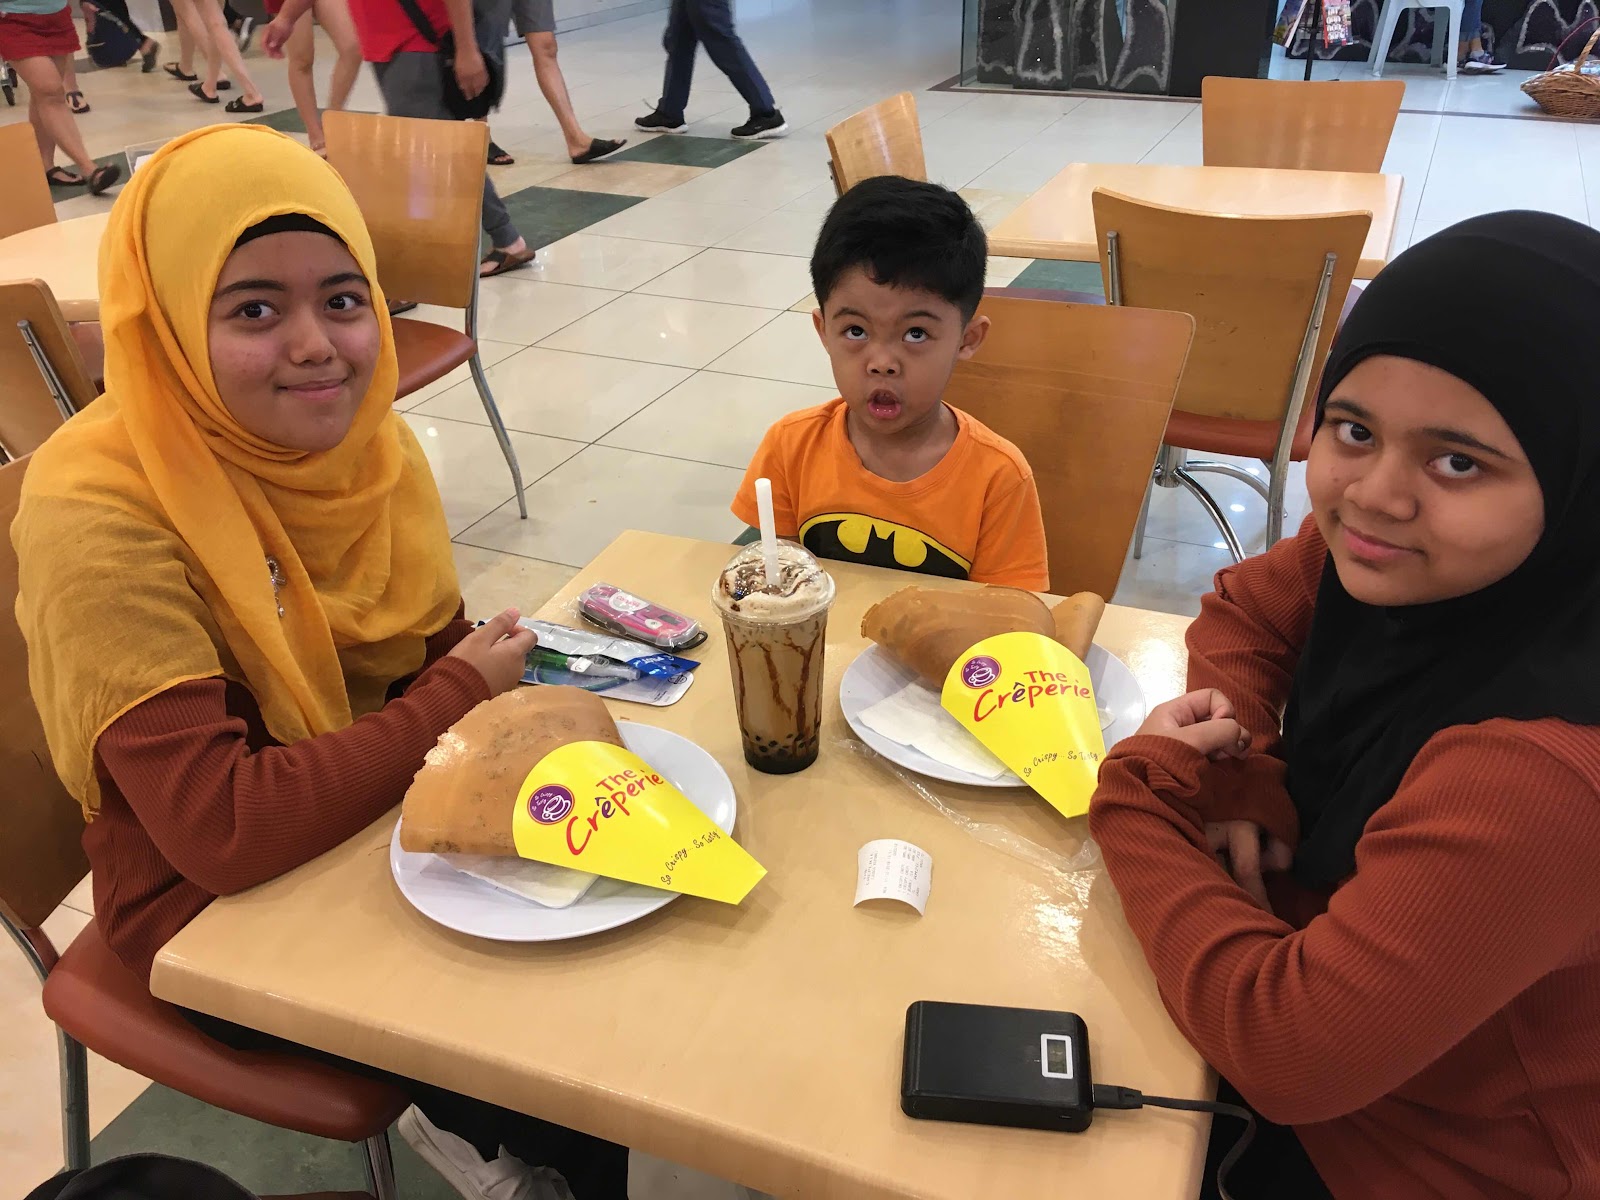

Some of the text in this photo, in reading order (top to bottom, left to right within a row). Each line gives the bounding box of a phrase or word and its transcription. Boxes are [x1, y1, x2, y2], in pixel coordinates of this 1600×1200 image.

[1023, 670, 1067, 683] The
[973, 682, 1091, 722] Crêperie
[595, 769, 637, 791] The
[1023, 767, 1032, 777] So
[1067, 750, 1078, 760] So
[566, 769, 664, 855] Crêperie
[660, 874, 671, 885] So
[692, 839, 704, 849] So
